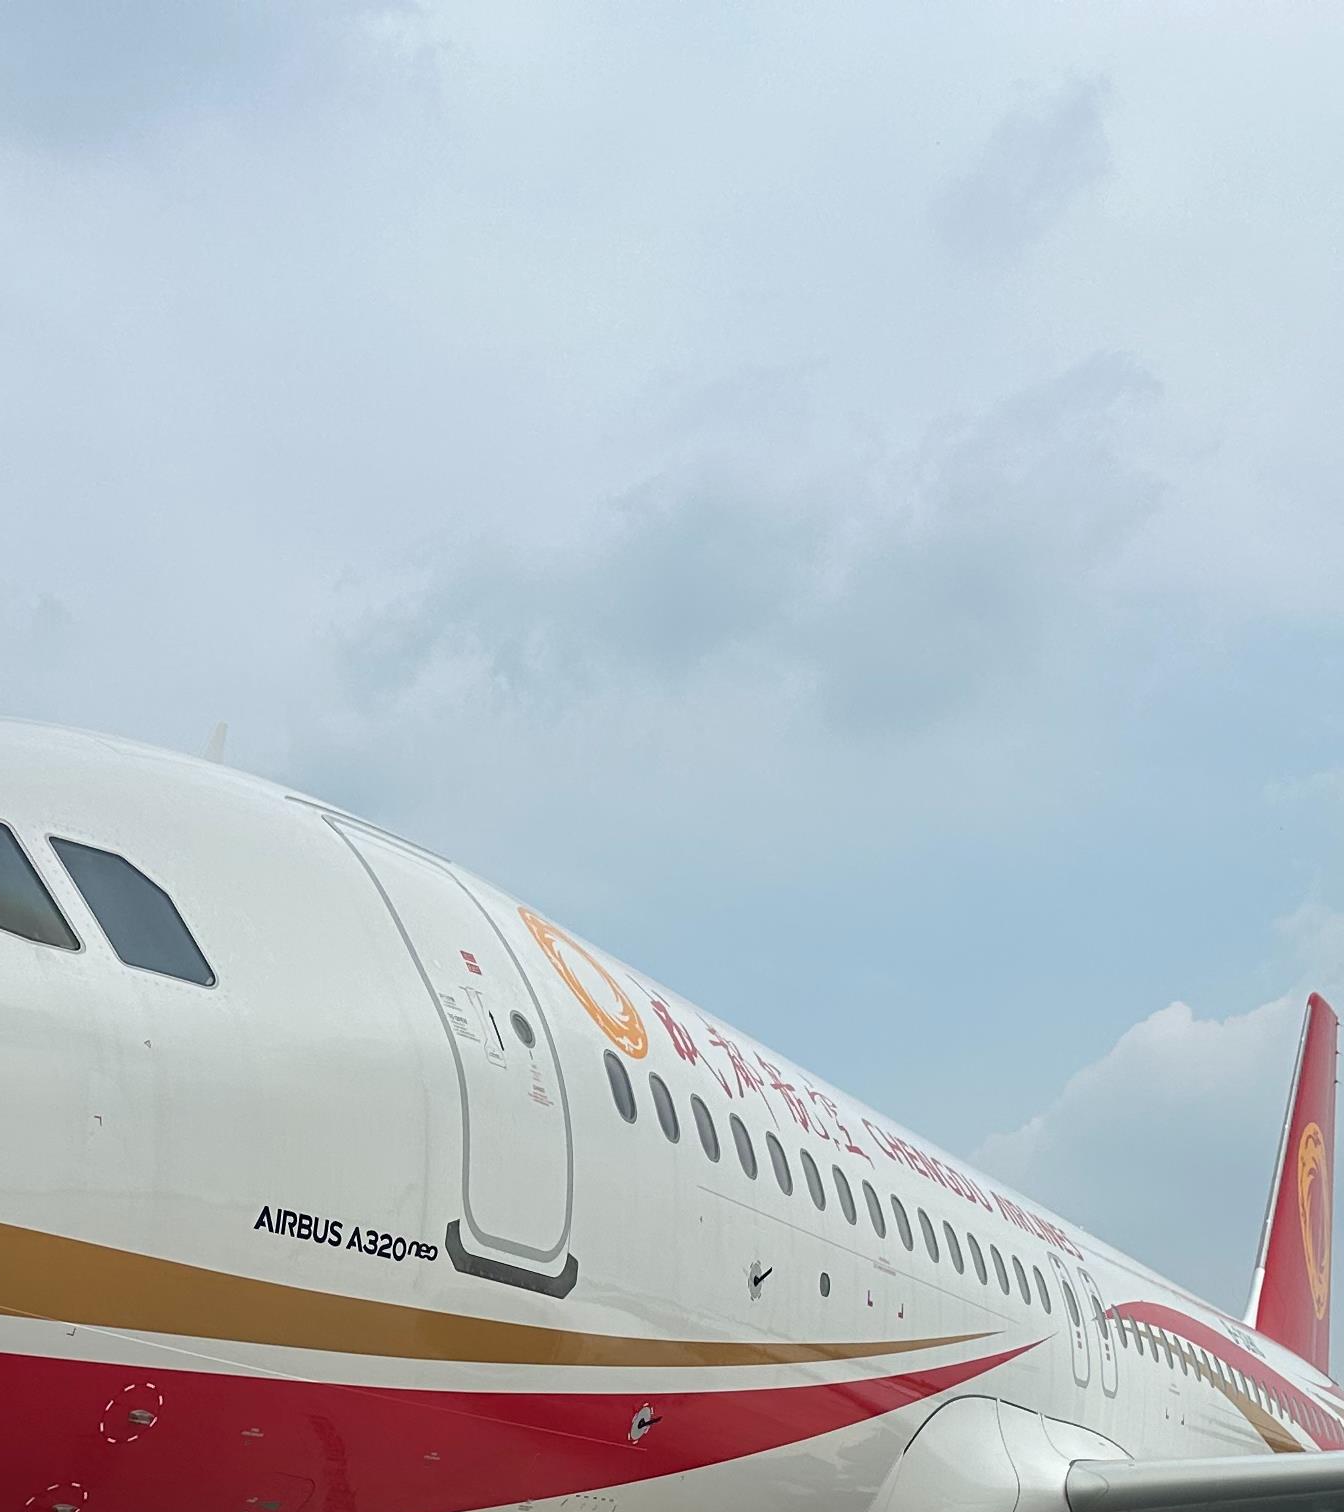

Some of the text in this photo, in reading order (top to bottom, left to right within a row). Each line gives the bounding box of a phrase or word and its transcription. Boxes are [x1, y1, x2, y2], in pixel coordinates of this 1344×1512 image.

[254, 1206, 343, 1247] AIRBUS
[861, 1118, 1084, 1261] CHENGDU AIRLINES
